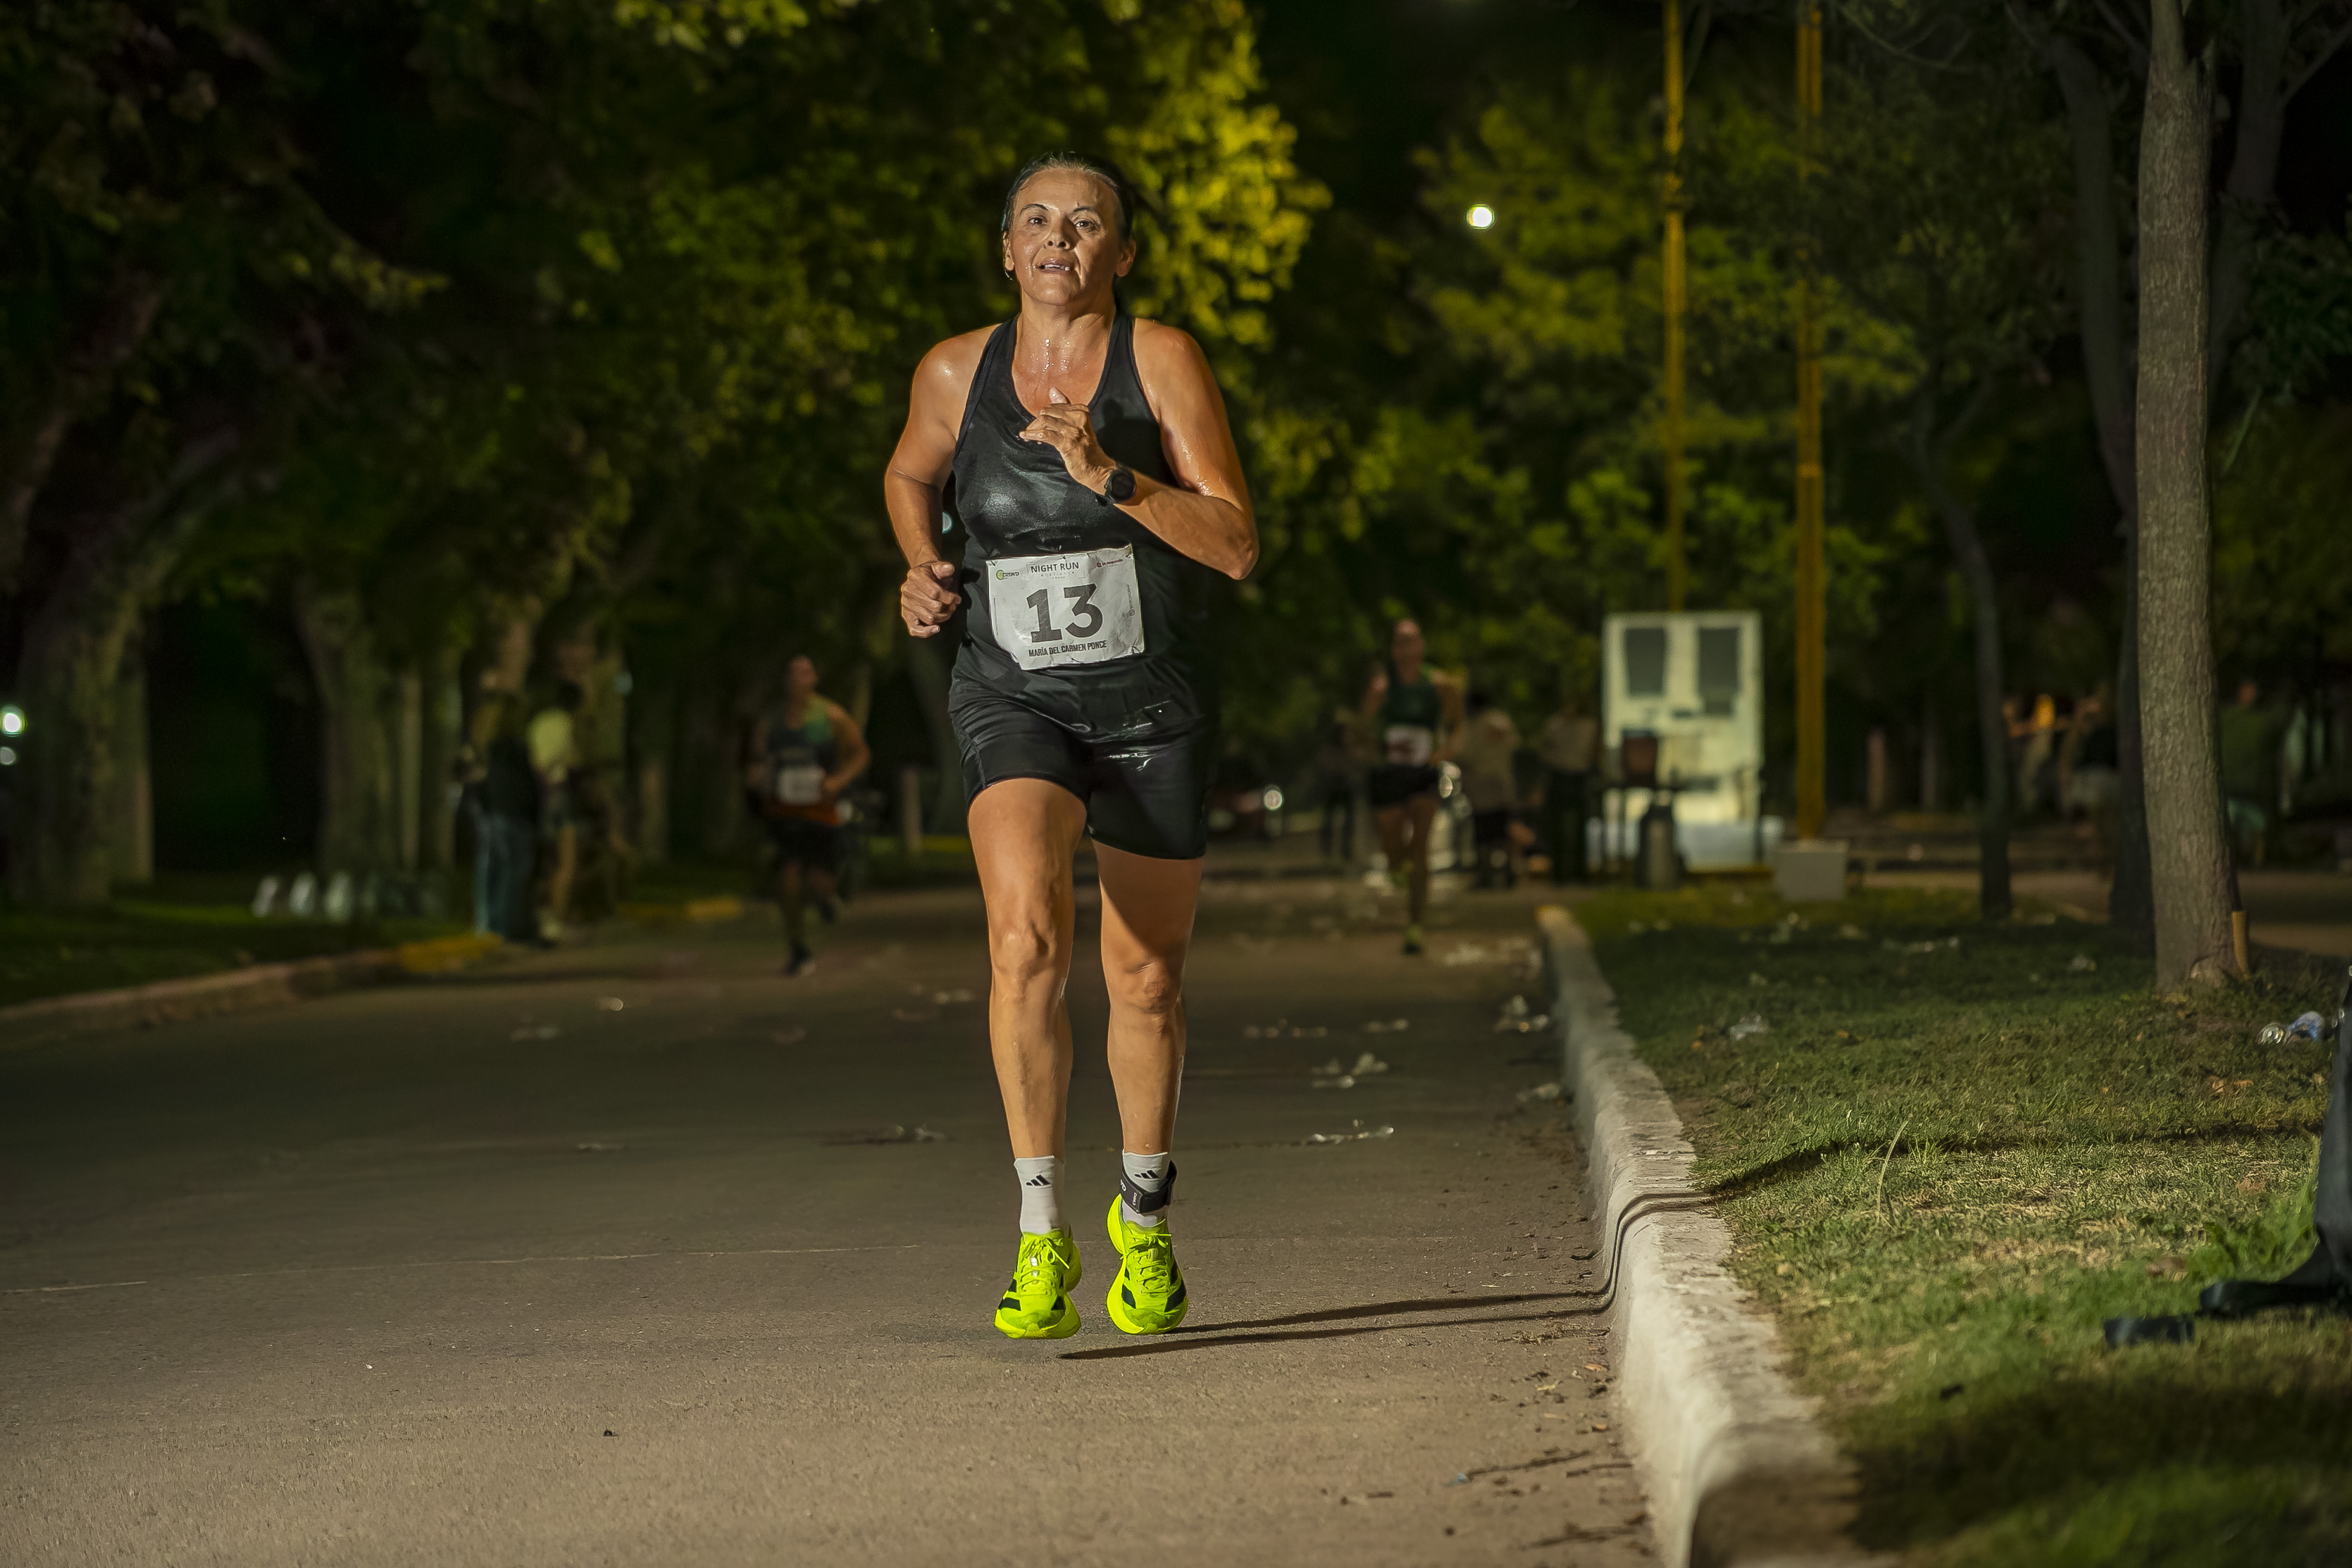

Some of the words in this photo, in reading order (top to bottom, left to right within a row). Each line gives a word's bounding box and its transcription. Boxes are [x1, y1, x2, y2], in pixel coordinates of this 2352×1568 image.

[1031, 564, 1057, 573] NIGHT
[1060, 561, 1079, 571] RUN
[1026, 583, 1103, 642] 13
[1028, 647, 1048, 657] MARÍA
[1050, 646, 1061, 655] DEL
[1062, 643, 1086, 653] CARMEN
[1088, 640, 1107, 650] PONCE
